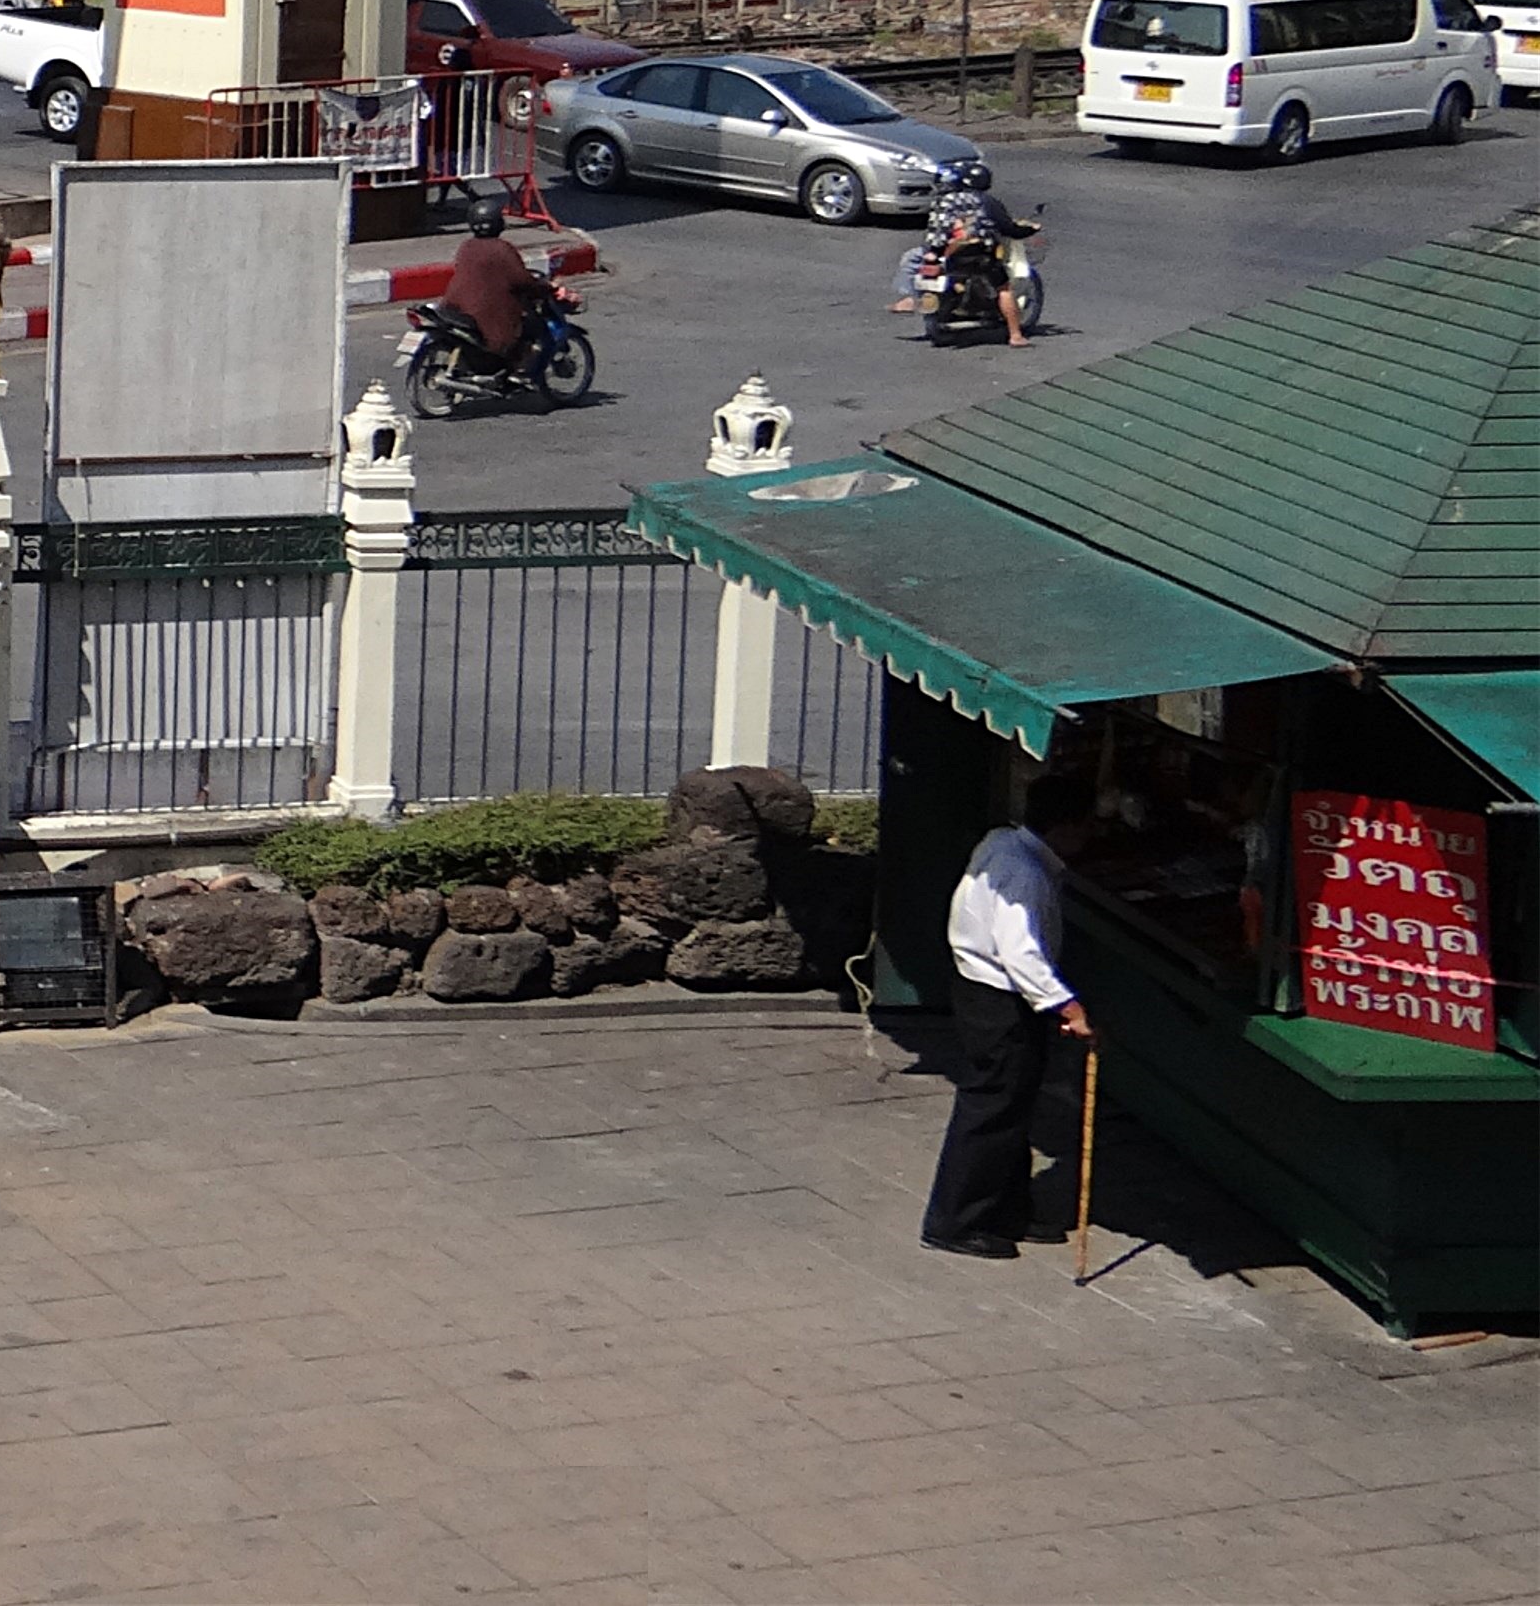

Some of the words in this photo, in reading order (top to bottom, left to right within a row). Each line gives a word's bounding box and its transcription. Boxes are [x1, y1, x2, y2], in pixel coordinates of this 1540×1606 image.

[1303, 800, 1477, 854] จำหน่าย
[1303, 834, 1478, 923] วัตถุ
[1306, 901, 1479, 956] มงคล
[1310, 976, 1486, 1034] พระกาฬ
